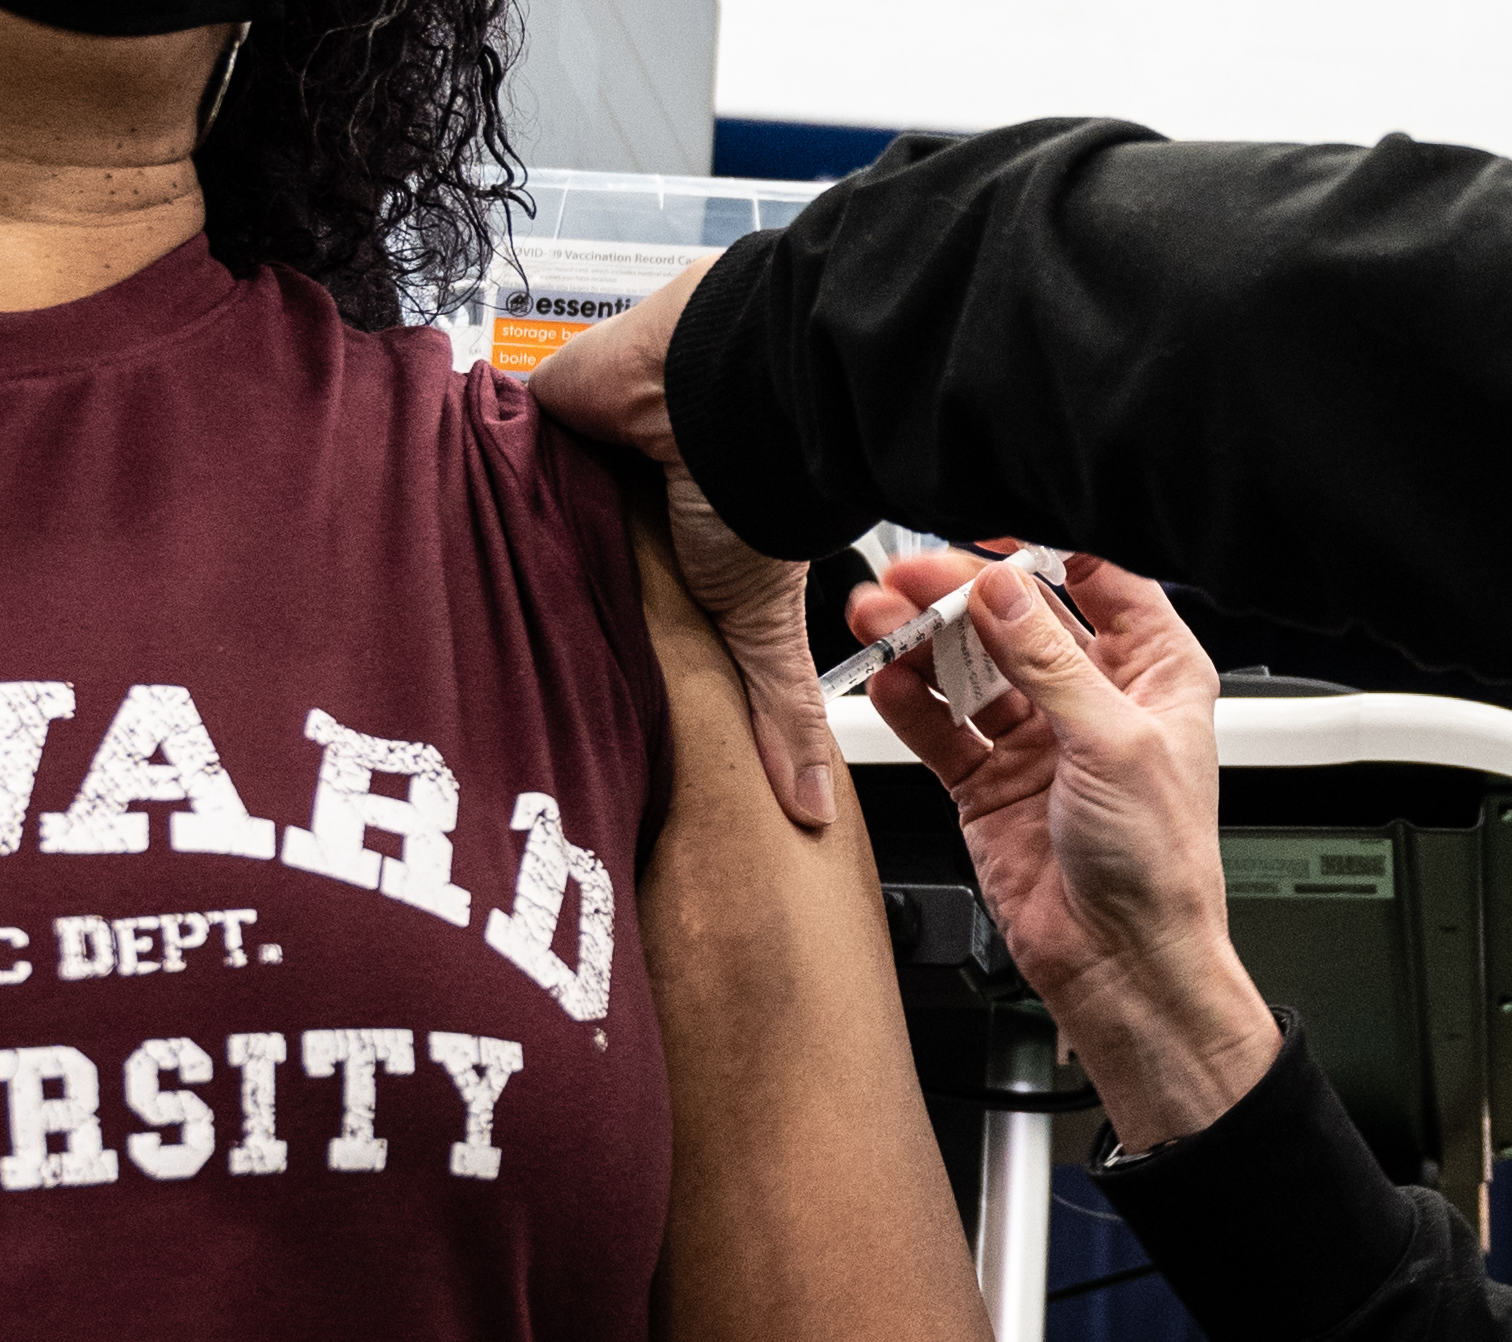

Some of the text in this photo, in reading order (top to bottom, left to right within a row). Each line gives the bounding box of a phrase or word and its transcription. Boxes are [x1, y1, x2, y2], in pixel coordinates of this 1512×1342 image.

[565, 249, 632, 263] Vaccination
[635, 253, 675, 265] Record
[502, 325, 557, 342] storage
[55, 908, 283, 981] DEPT.
